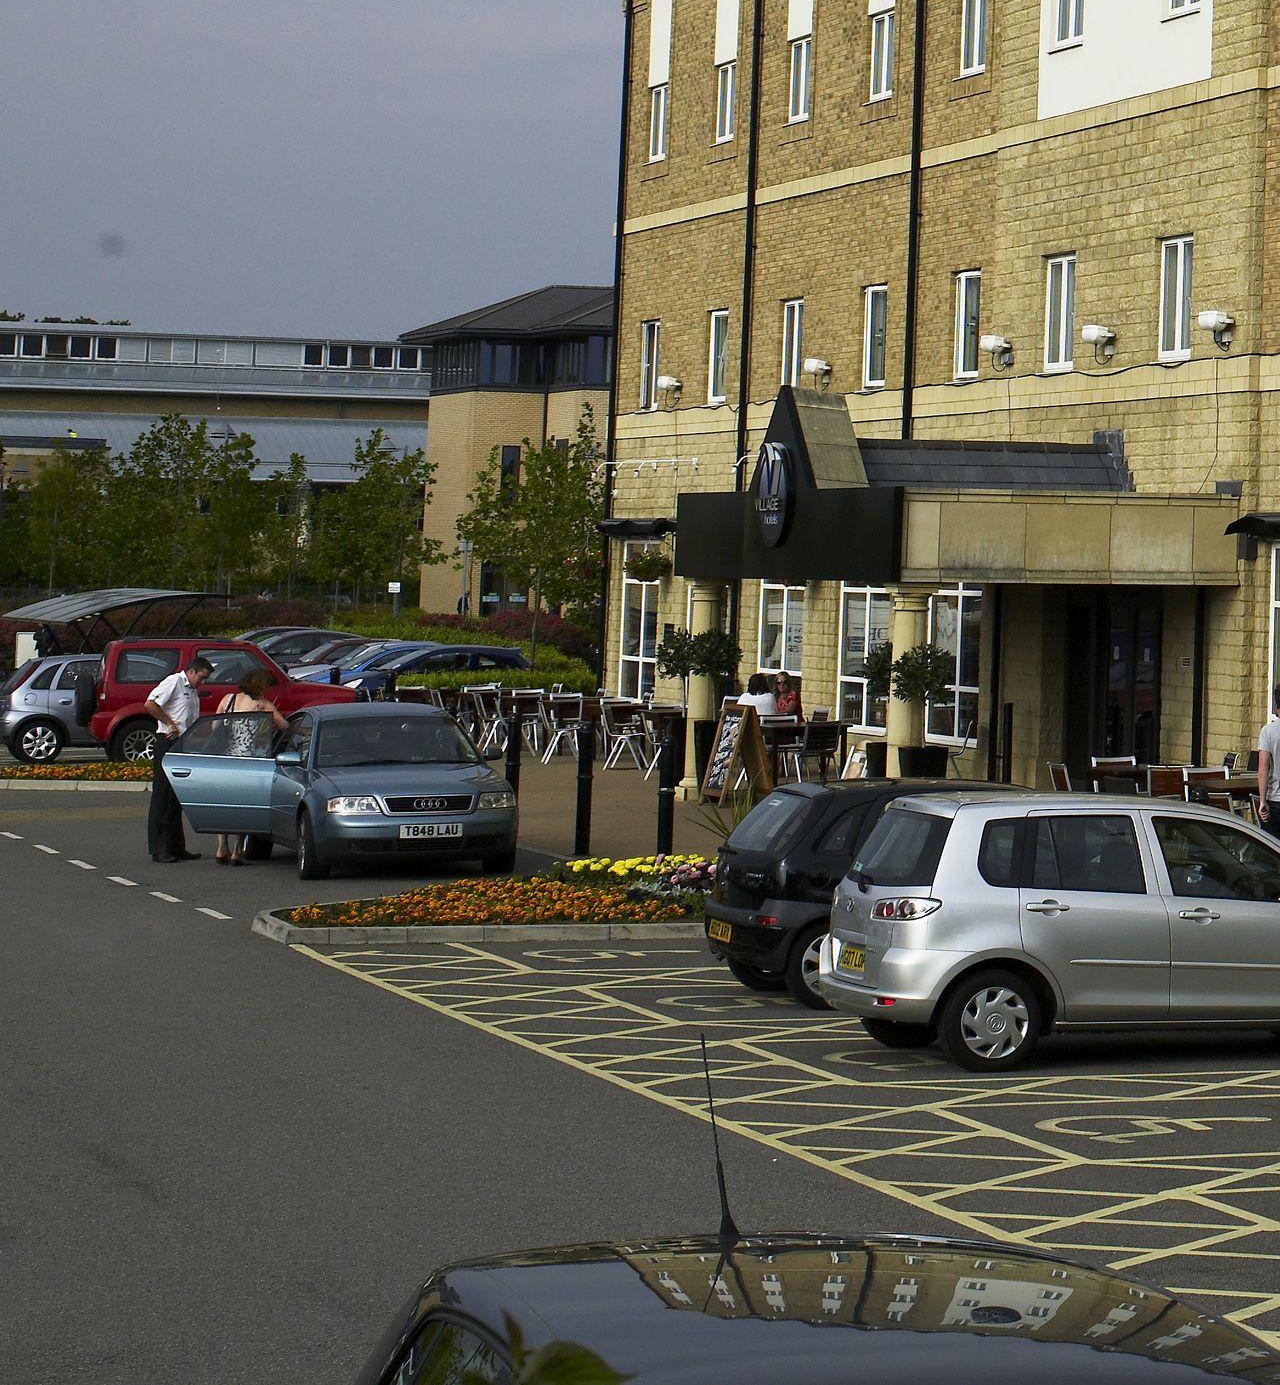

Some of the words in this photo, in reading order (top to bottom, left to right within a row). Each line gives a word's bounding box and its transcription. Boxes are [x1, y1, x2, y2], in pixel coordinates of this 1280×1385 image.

[755, 498, 779, 511] VILLAGE
[405, 825, 434, 836] T848
[437, 824, 458, 836] LAU
